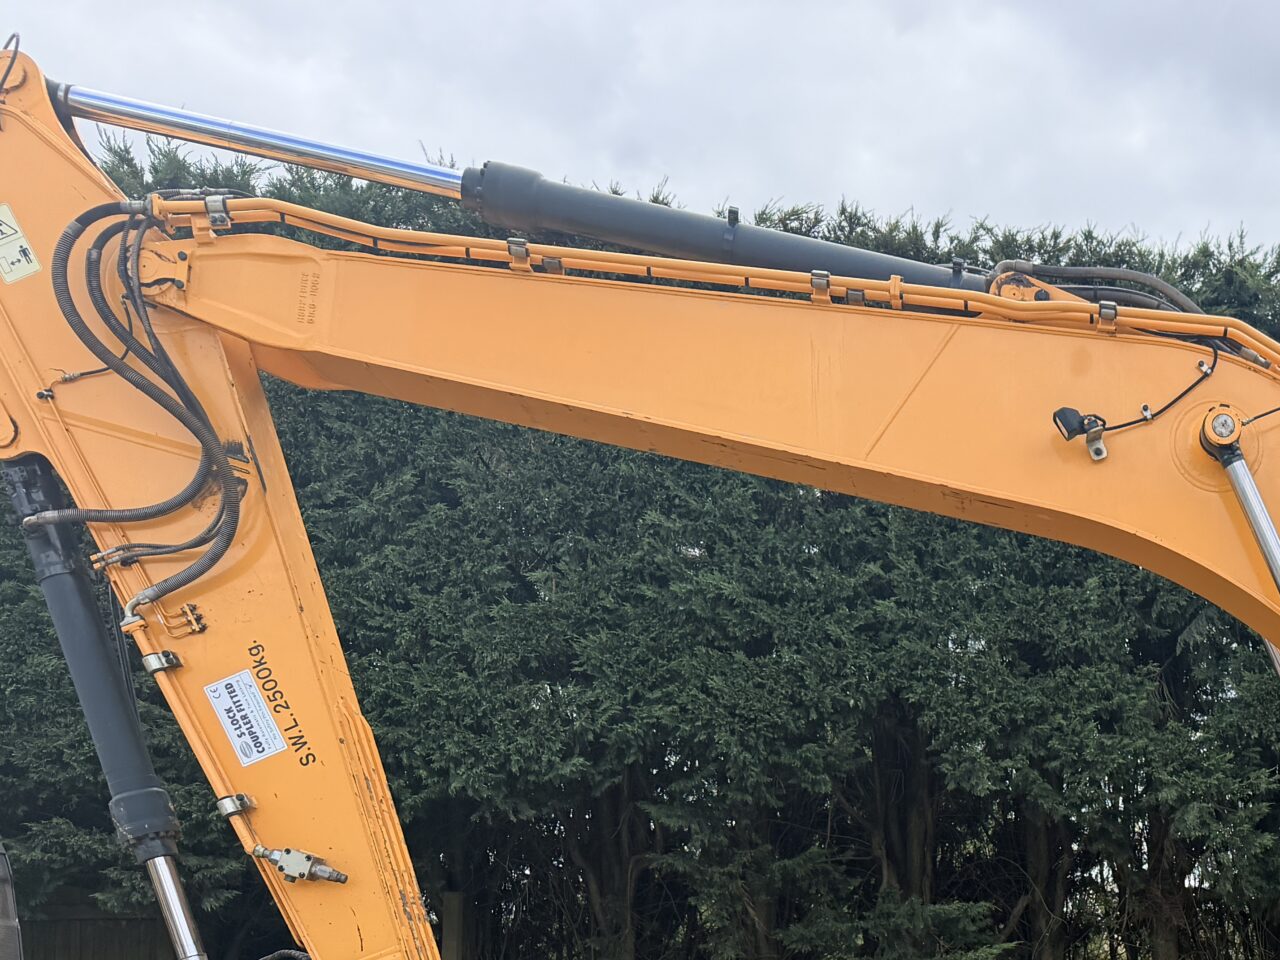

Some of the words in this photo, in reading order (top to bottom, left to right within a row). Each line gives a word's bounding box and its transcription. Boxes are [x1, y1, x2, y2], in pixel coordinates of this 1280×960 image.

[224, 682, 246, 713] FITTED
[224, 706, 247, 739] S-LOCK
[239, 713, 266, 754] COUPLER
